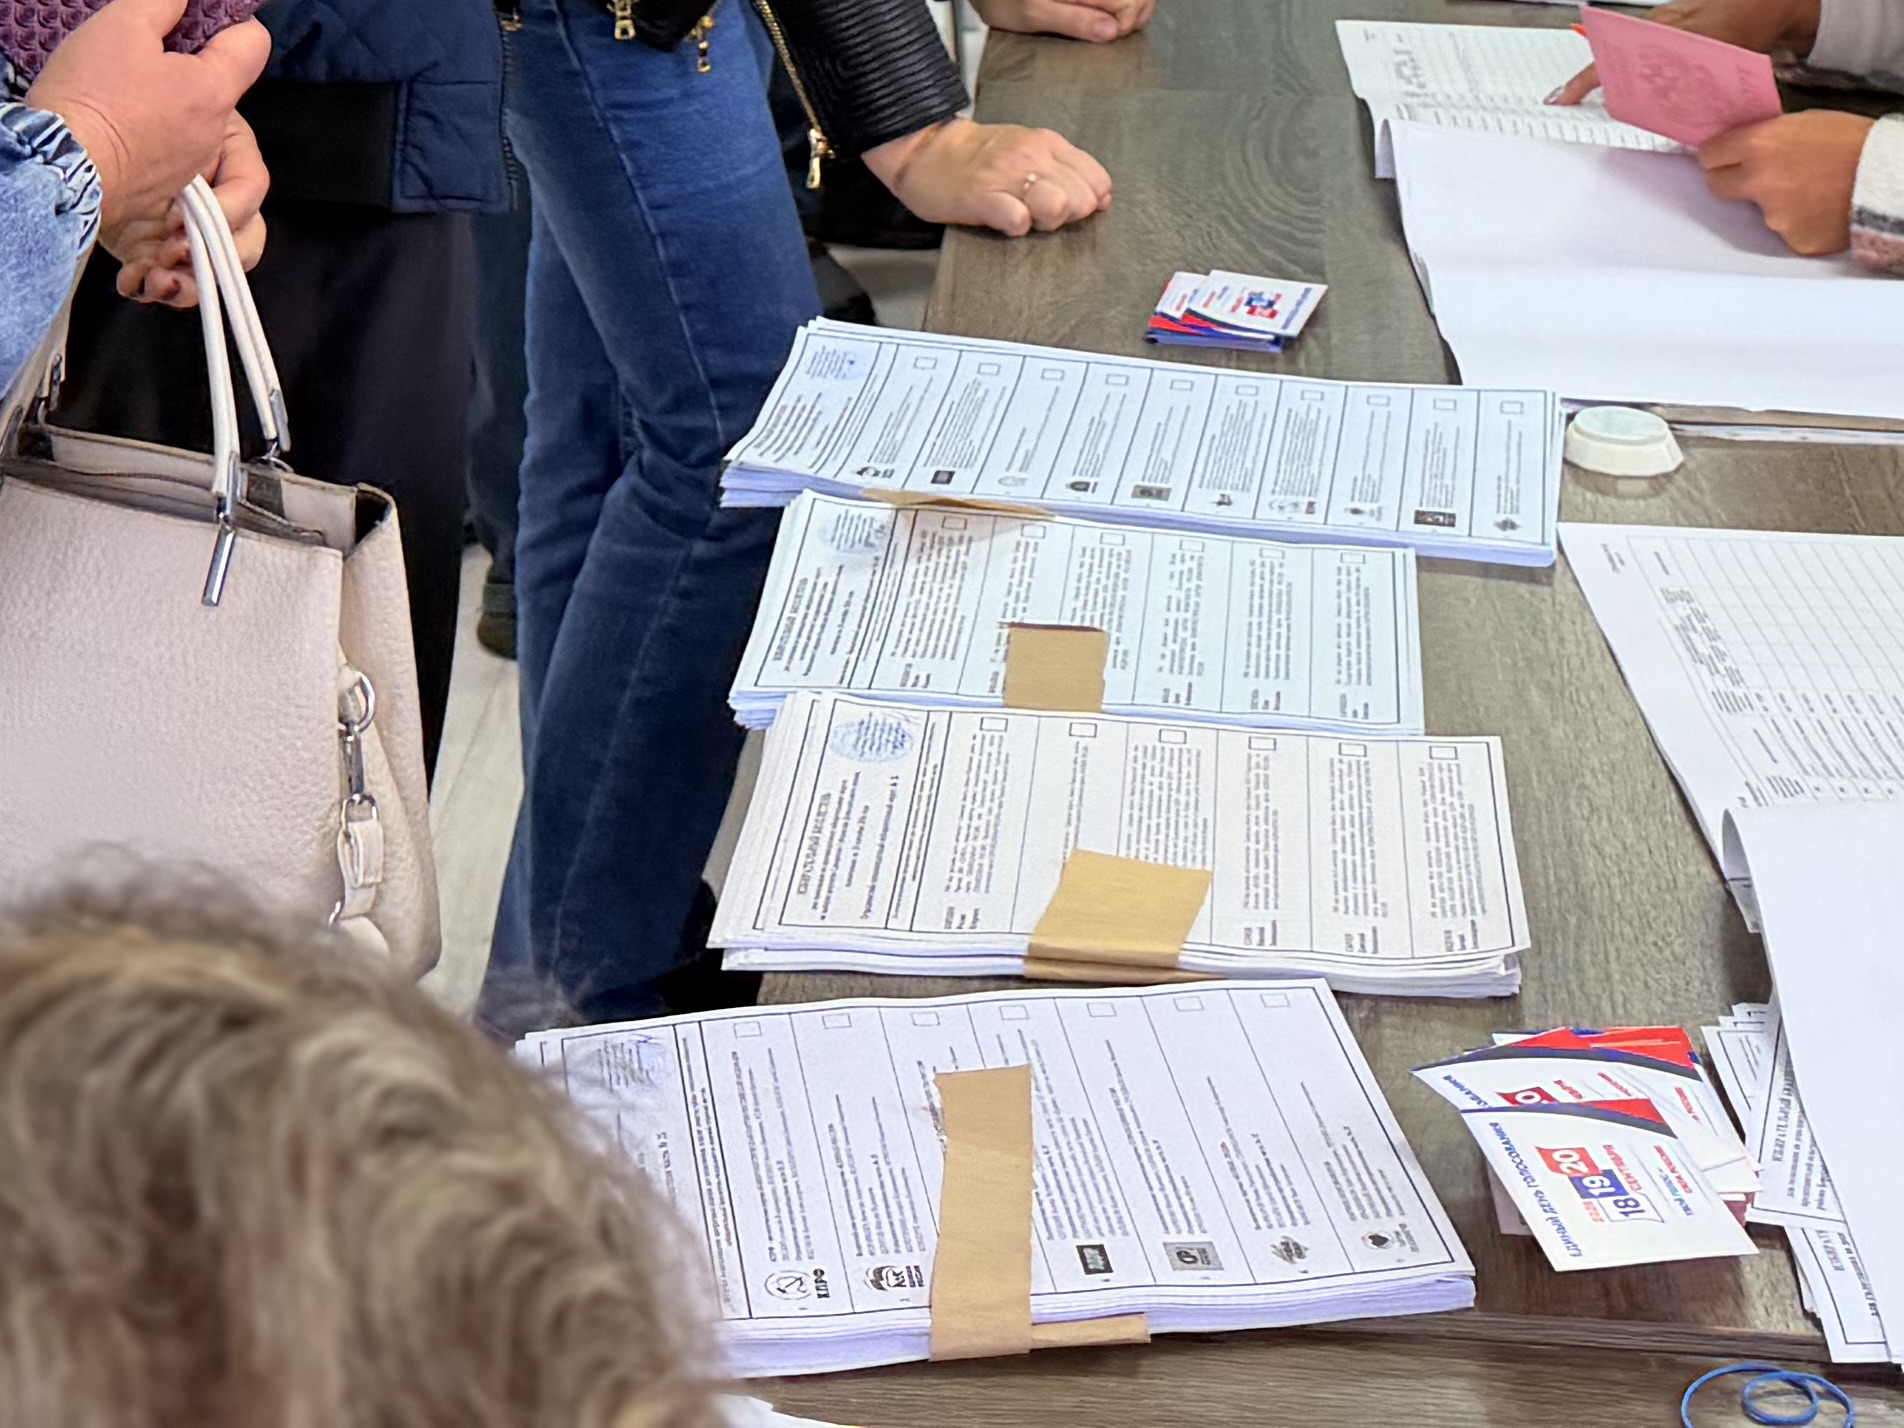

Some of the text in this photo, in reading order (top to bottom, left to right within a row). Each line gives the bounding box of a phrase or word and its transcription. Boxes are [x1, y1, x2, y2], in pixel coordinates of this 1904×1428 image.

[1553, 1149, 1646, 1217] 18 19 20
[1552, 1216, 1582, 1257] ЕДИНЫЙ
[812, 1267, 830, 1299] КПРФ
